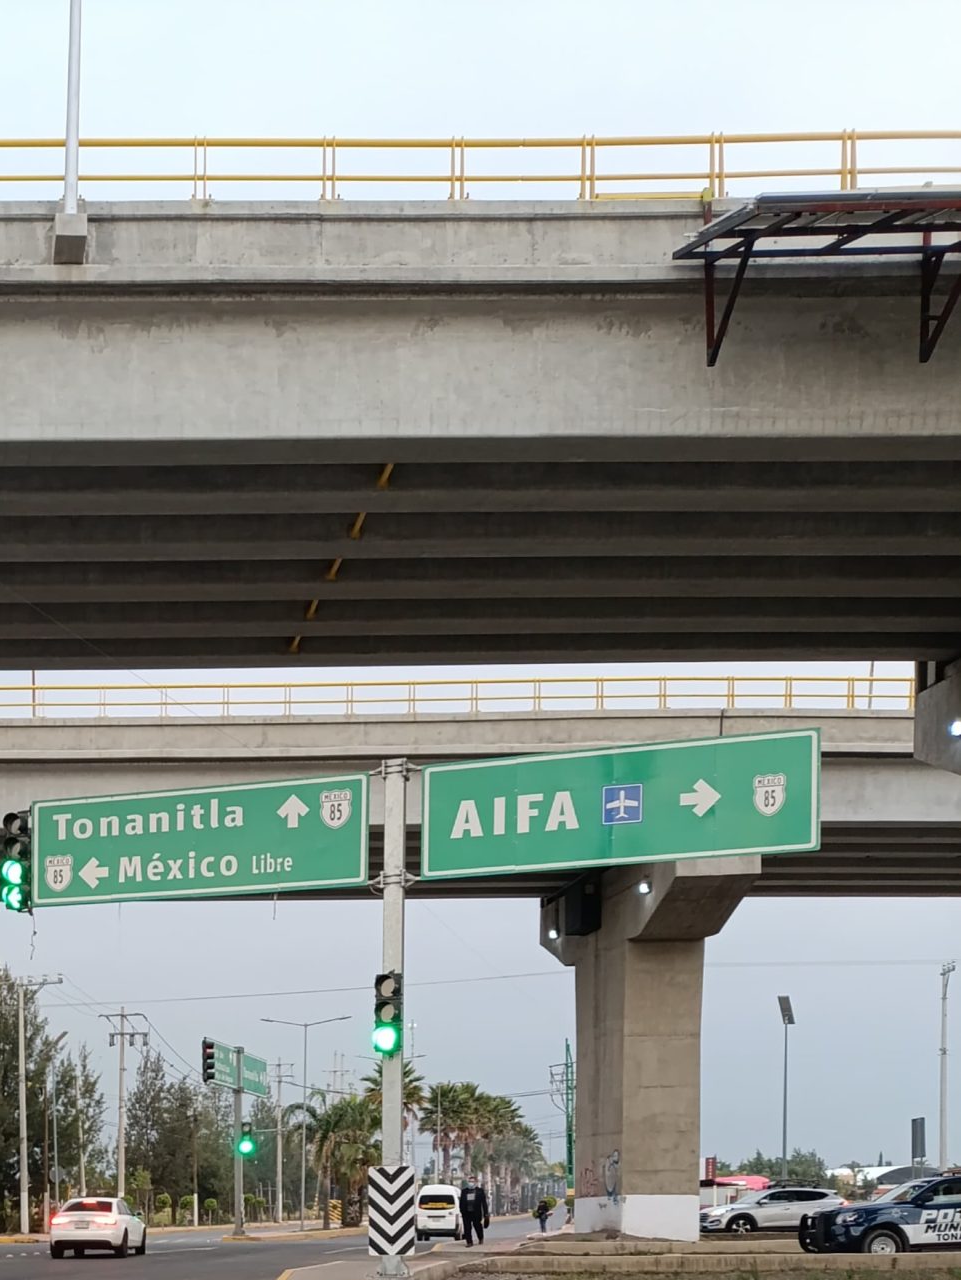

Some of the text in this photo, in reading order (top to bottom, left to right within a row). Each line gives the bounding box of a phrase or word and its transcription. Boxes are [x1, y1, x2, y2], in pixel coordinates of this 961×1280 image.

[763, 790, 777, 808] 85
[52, 798, 245, 842] Tonanitla
[329, 802, 343, 822] 85
[450, 790, 580, 840] AIFA
[52, 869, 65, 885] 85
[118, 852, 293, 884] México Libre
[924, 1223, 961, 1234] MUN
